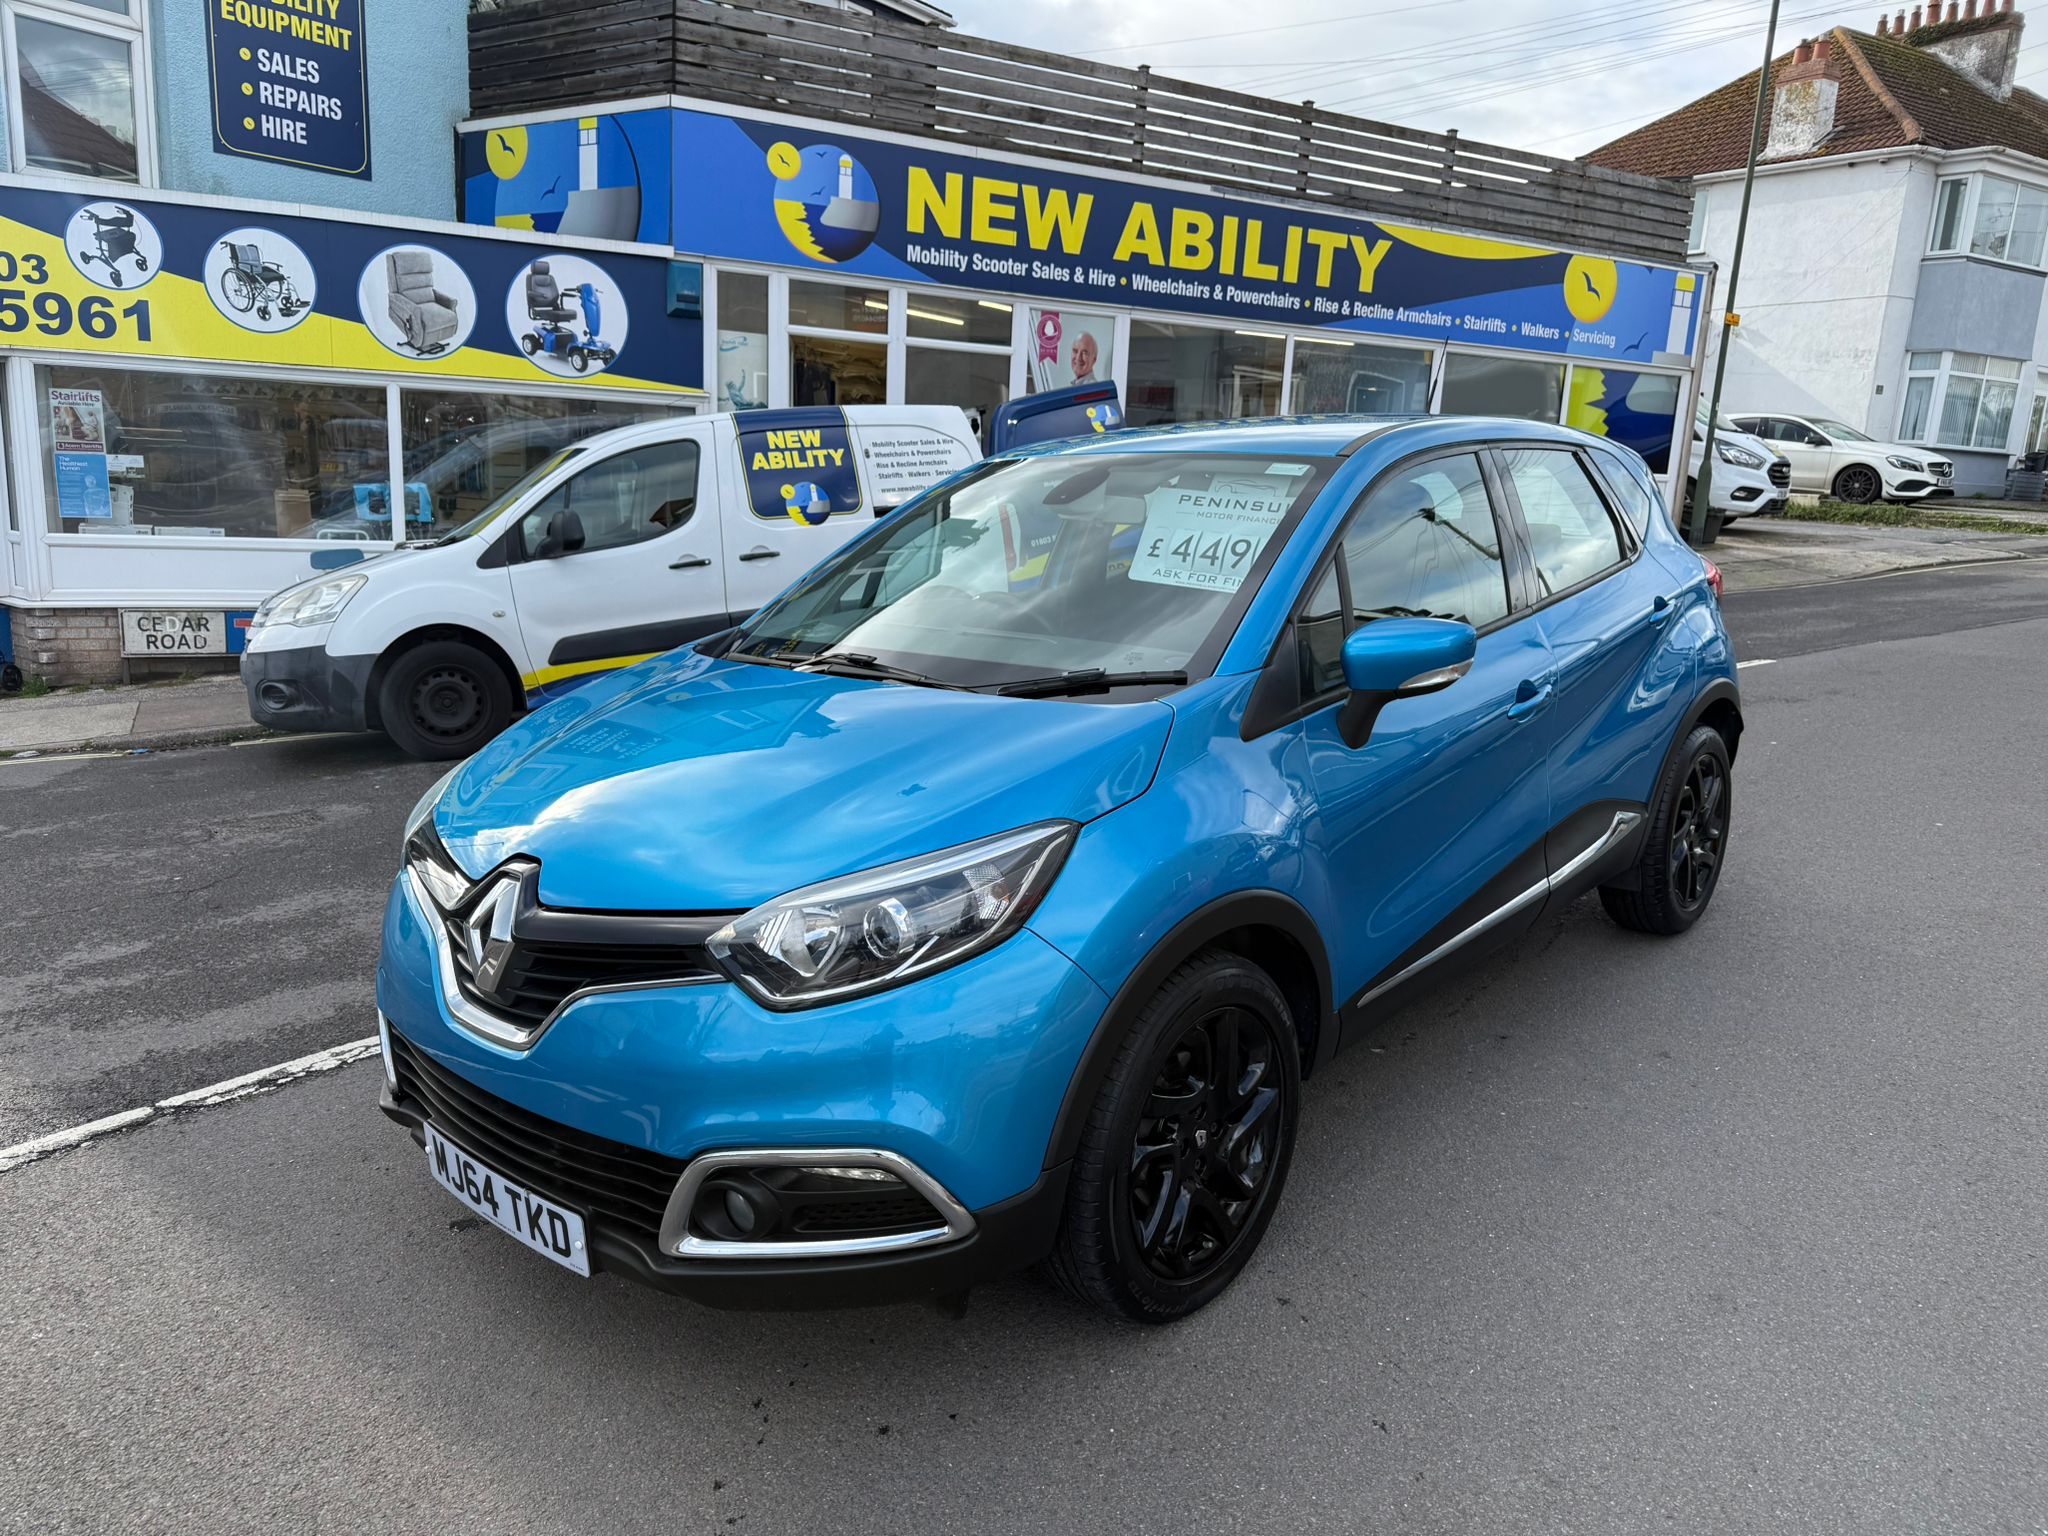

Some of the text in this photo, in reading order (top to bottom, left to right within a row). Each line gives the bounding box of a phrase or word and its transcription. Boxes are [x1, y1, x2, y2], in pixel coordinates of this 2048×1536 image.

[221, 0, 352, 51] EQUIPMENT
[257, 48, 320, 84] SALES
[259, 81, 343, 121] REPAIRS
[261, 114, 308, 146] HIRE
[906, 165, 1394, 293] NEW ABILITY
[0, 251, 49, 285] 03
[906, 244, 1616, 349] Mobility Scooter Sales & Hire Wheelchairs & Powerchairs Rise & Recline Armchairs Stairlifts Walkers Servicing
[0, 288, 152, 342] 5961
[51, 390, 100, 403] Stairlifts
[766, 429, 821, 449] NEW
[872, 441, 896, 449] Mobility
[920, 438, 935, 446] Sales
[752, 448, 844, 471] ABILITY
[874, 450, 910, 459] Wheelchairs
[917, 448, 952, 456] Powerchairs
[878, 472, 904, 480] Stairlifts
[907, 470, 931, 478] Walkers
[1197, 511, 1233, 521] MOTOR
[1152, 568, 1183, 580] ASK
[1188, 572, 1218, 585] FOR
[137, 615, 211, 632] CEDAR
[146, 633, 208, 650] ROAD
[432, 1134, 572, 1259] MJ64 TKD
